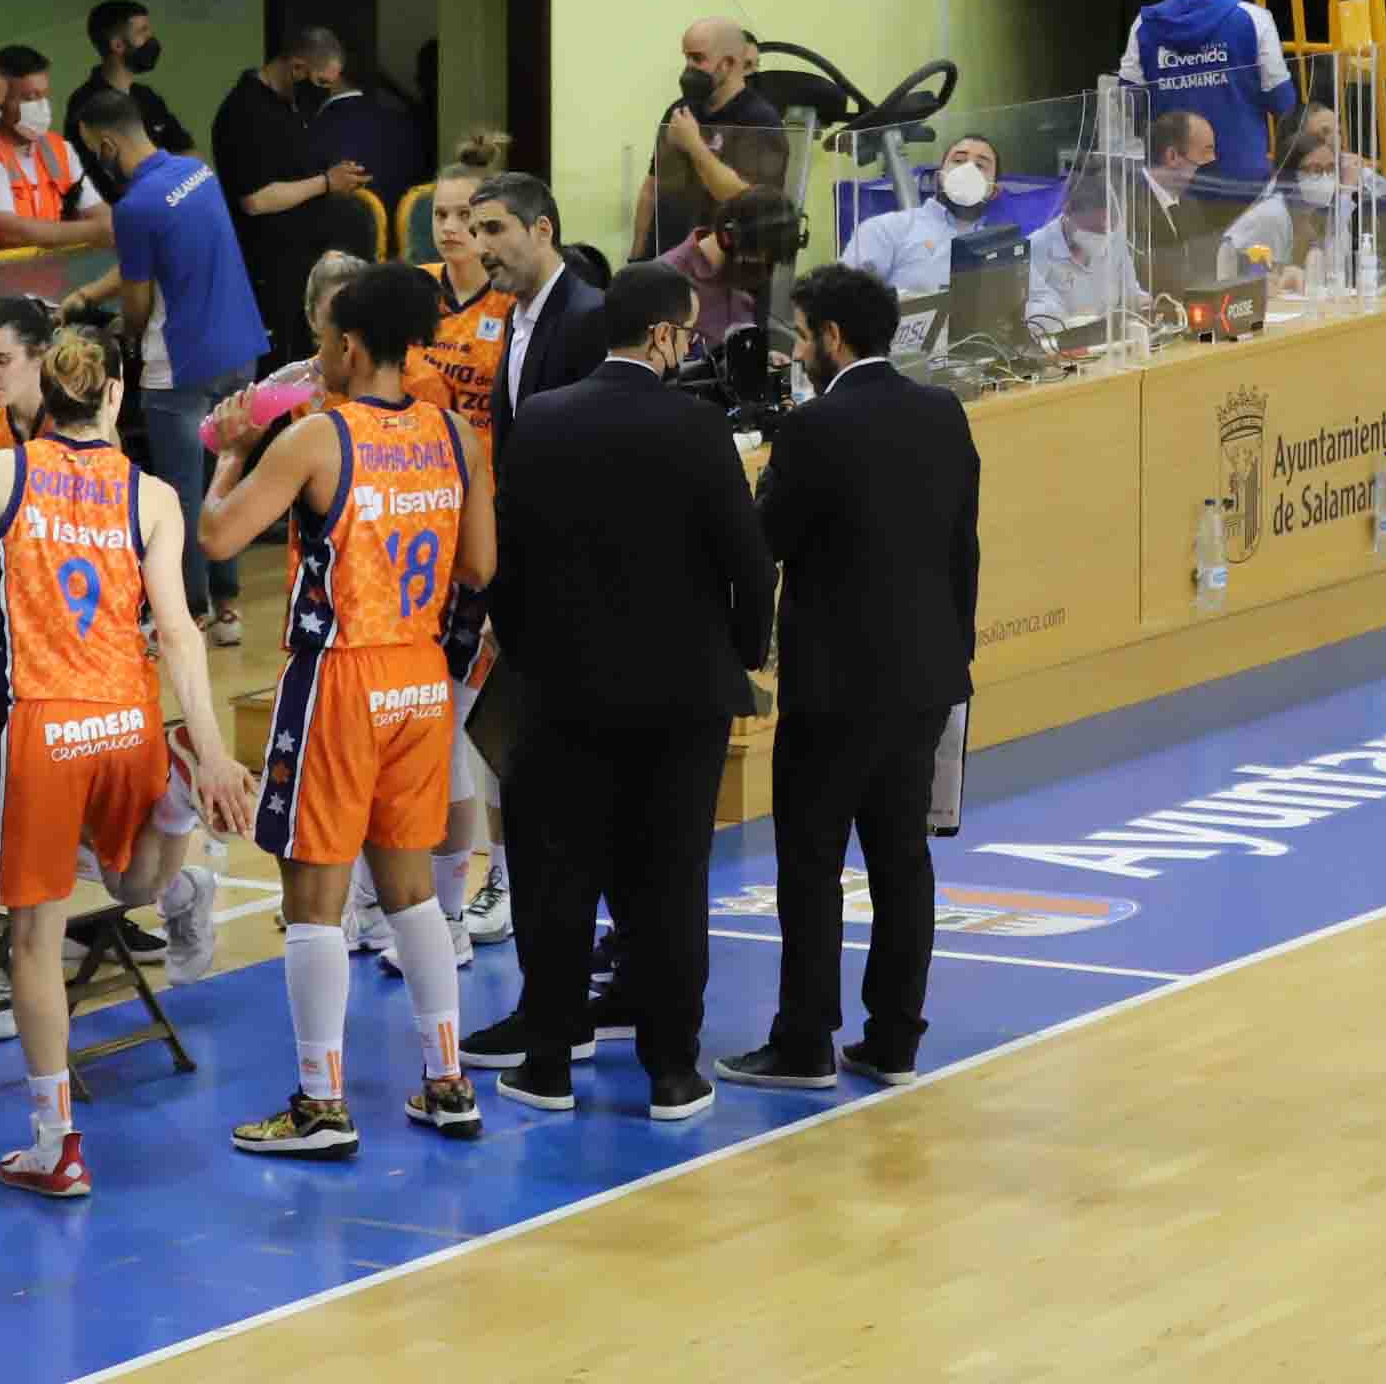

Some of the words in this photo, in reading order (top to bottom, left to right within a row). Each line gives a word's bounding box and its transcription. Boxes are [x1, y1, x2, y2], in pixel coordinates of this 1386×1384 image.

[389, 485, 462, 516] isaval
[1273, 492, 1294, 535] de
[58, 556, 102, 641] 9
[369, 679, 448, 713] PAMESA
[44, 707, 144, 746] PAMESA
